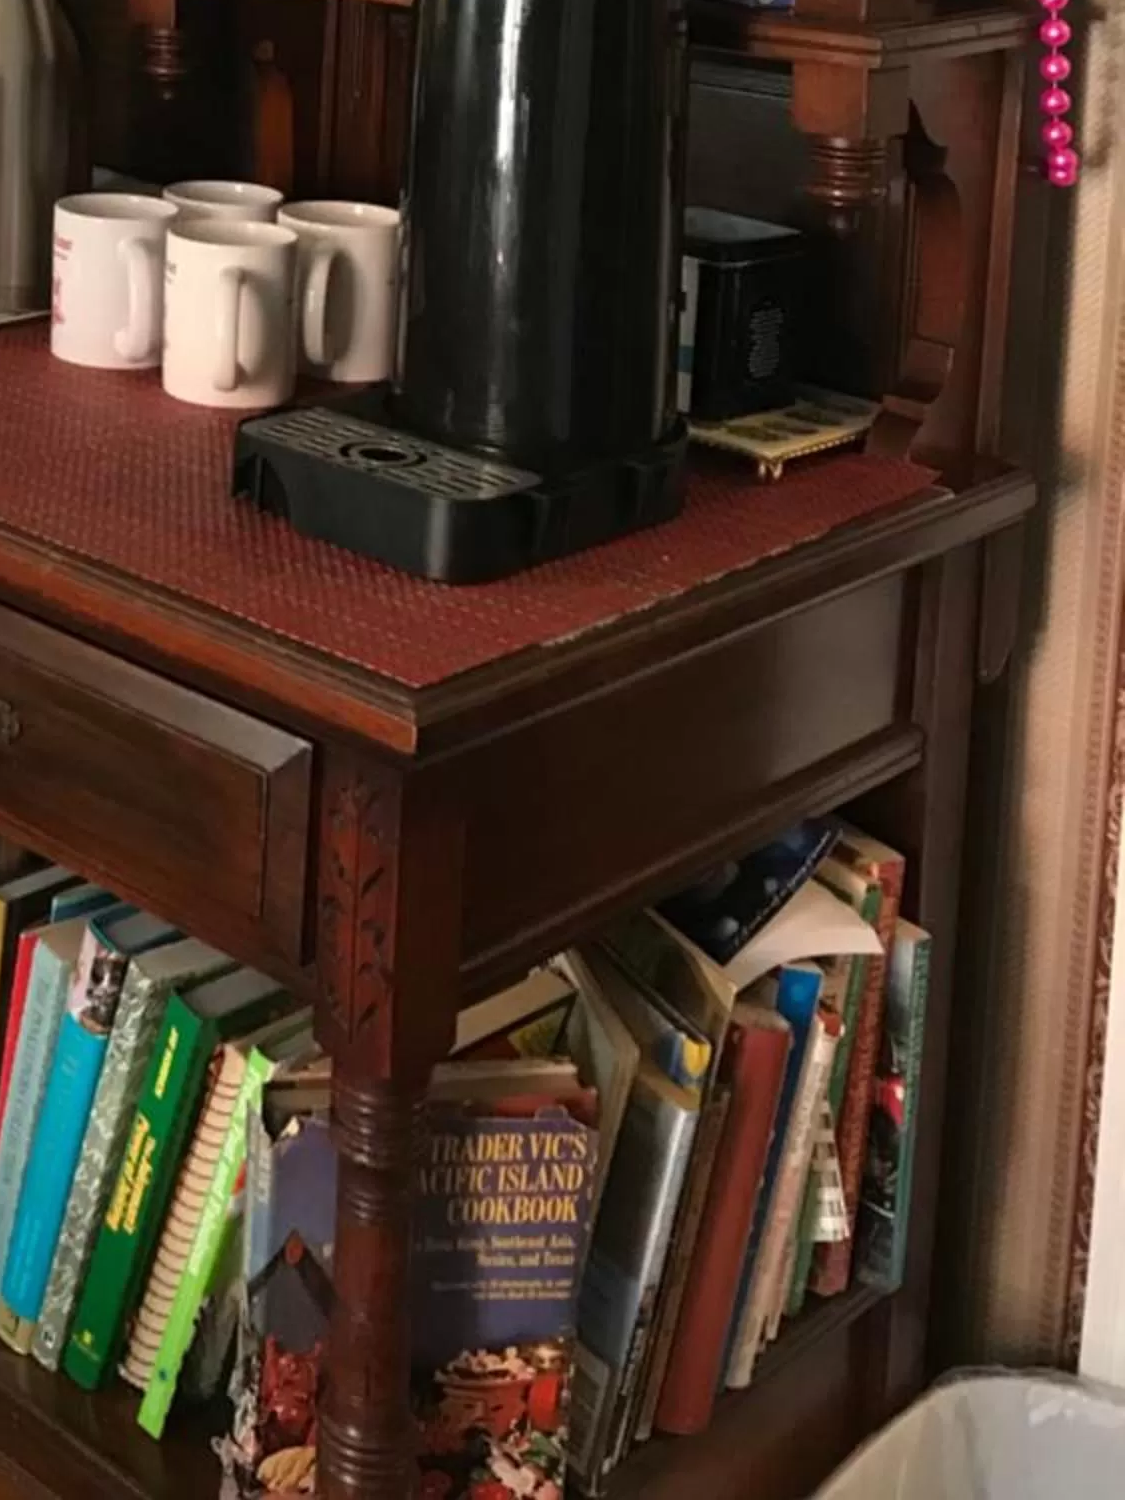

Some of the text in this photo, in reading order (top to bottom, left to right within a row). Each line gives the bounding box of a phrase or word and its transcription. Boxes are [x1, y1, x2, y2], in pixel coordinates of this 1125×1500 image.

[431, 1131, 588, 1163] TRADER VIC'S
[497, 1163, 584, 1192] ISLAND
[447, 1195, 578, 1226] COOKBOOK
